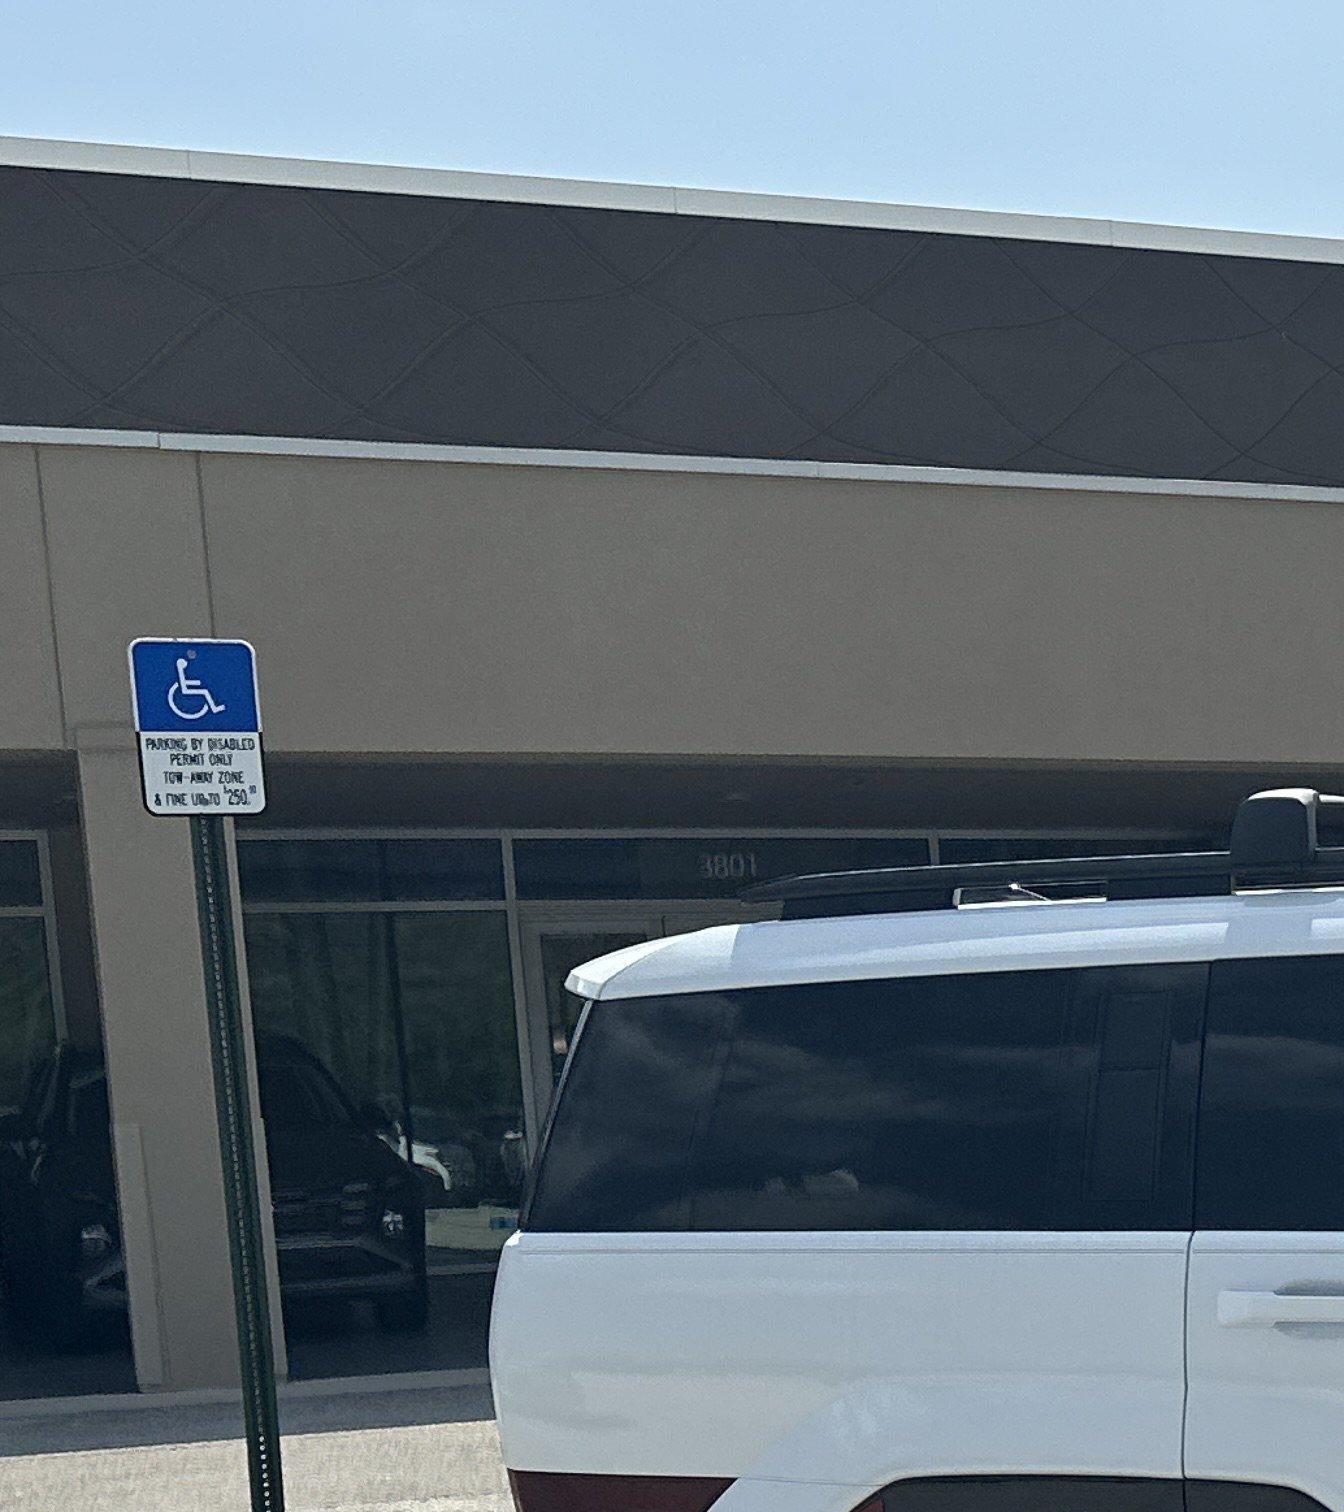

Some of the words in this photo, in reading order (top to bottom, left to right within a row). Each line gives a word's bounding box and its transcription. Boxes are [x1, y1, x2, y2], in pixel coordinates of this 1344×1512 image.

[145, 737, 188, 751] PARKING
[190, 737, 204, 750] BY
[207, 737, 256, 751] DISABLED
[169, 753, 205, 767] PERMIT
[208, 753, 234, 767] ONLY
[163, 770, 214, 784] TOW-AWAY
[217, 770, 245, 785] ZONE
[165, 793, 188, 806] FINE
[697, 852, 758, 880] 3801
